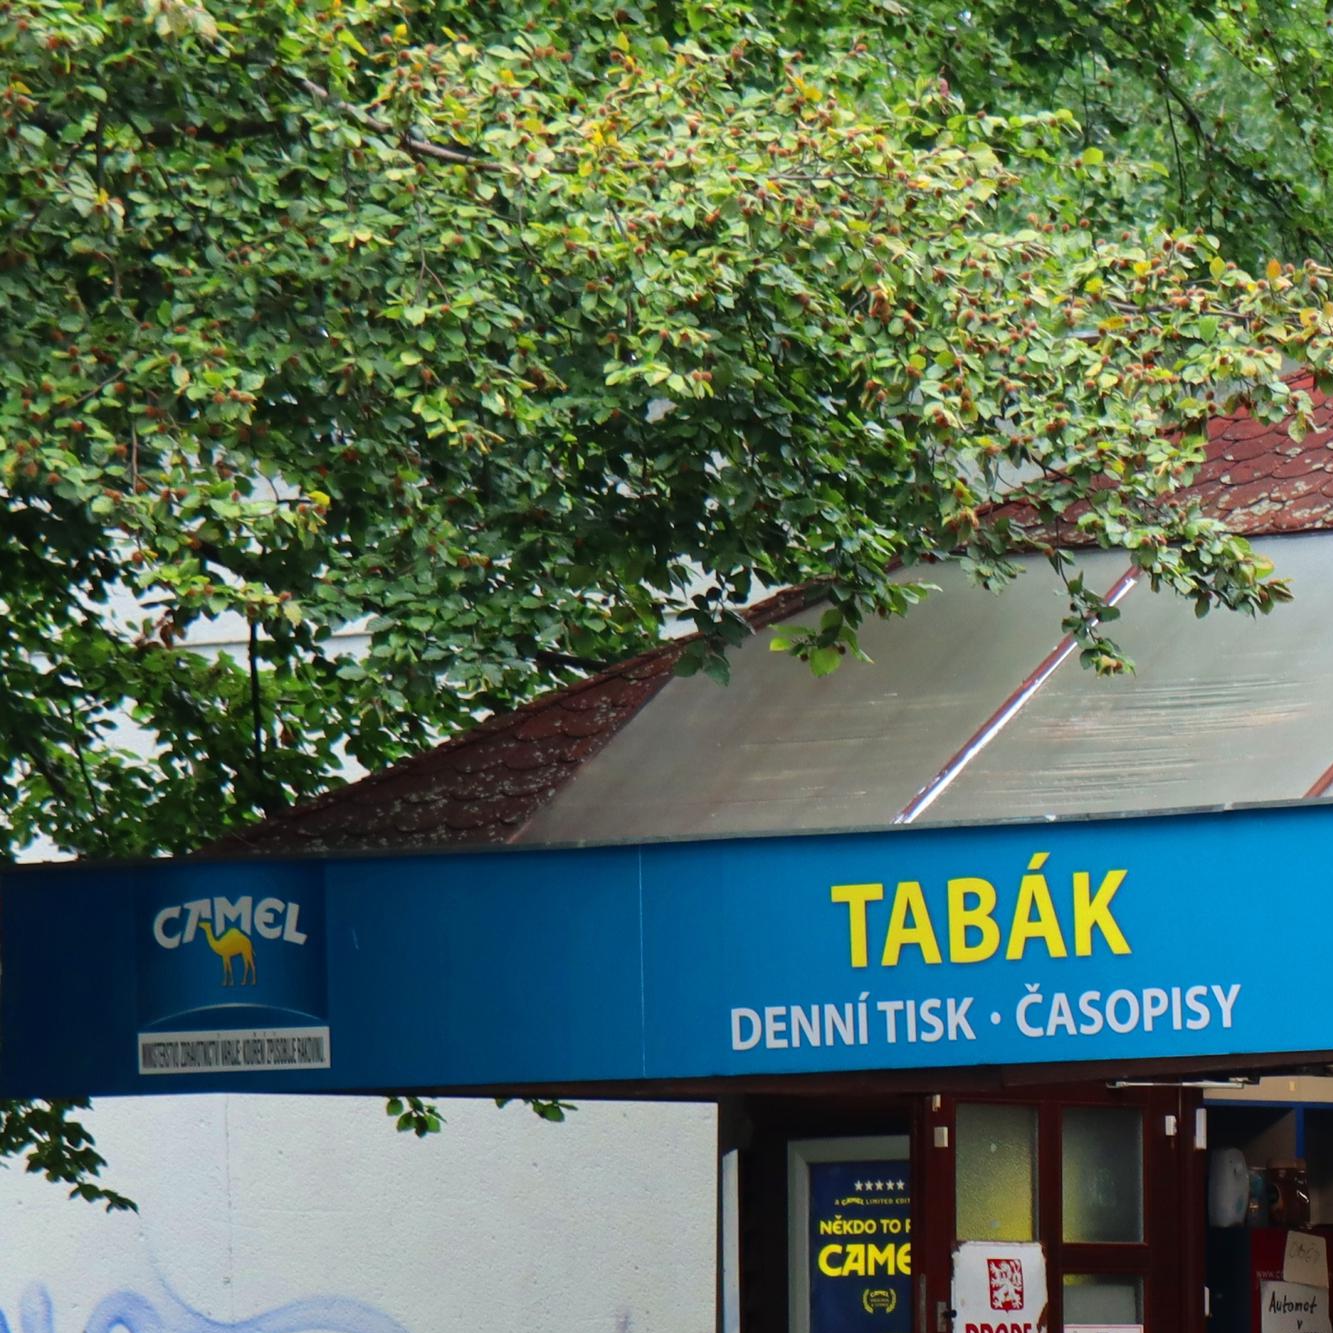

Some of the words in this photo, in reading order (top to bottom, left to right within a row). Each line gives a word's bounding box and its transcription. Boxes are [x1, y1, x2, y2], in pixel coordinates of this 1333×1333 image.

[153, 895, 307, 949] CAMEL
[831, 852, 1131, 968] TABÁK
[730, 992, 870, 1050] DENNÍ
[878, 997, 976, 1043] TISK
[1016, 983, 1241, 1037] ČASOPISY
[819, 1215, 877, 1235] NĚKDO
[880, 1219, 902, 1234] TO
[818, 1243, 911, 1278] CAME
